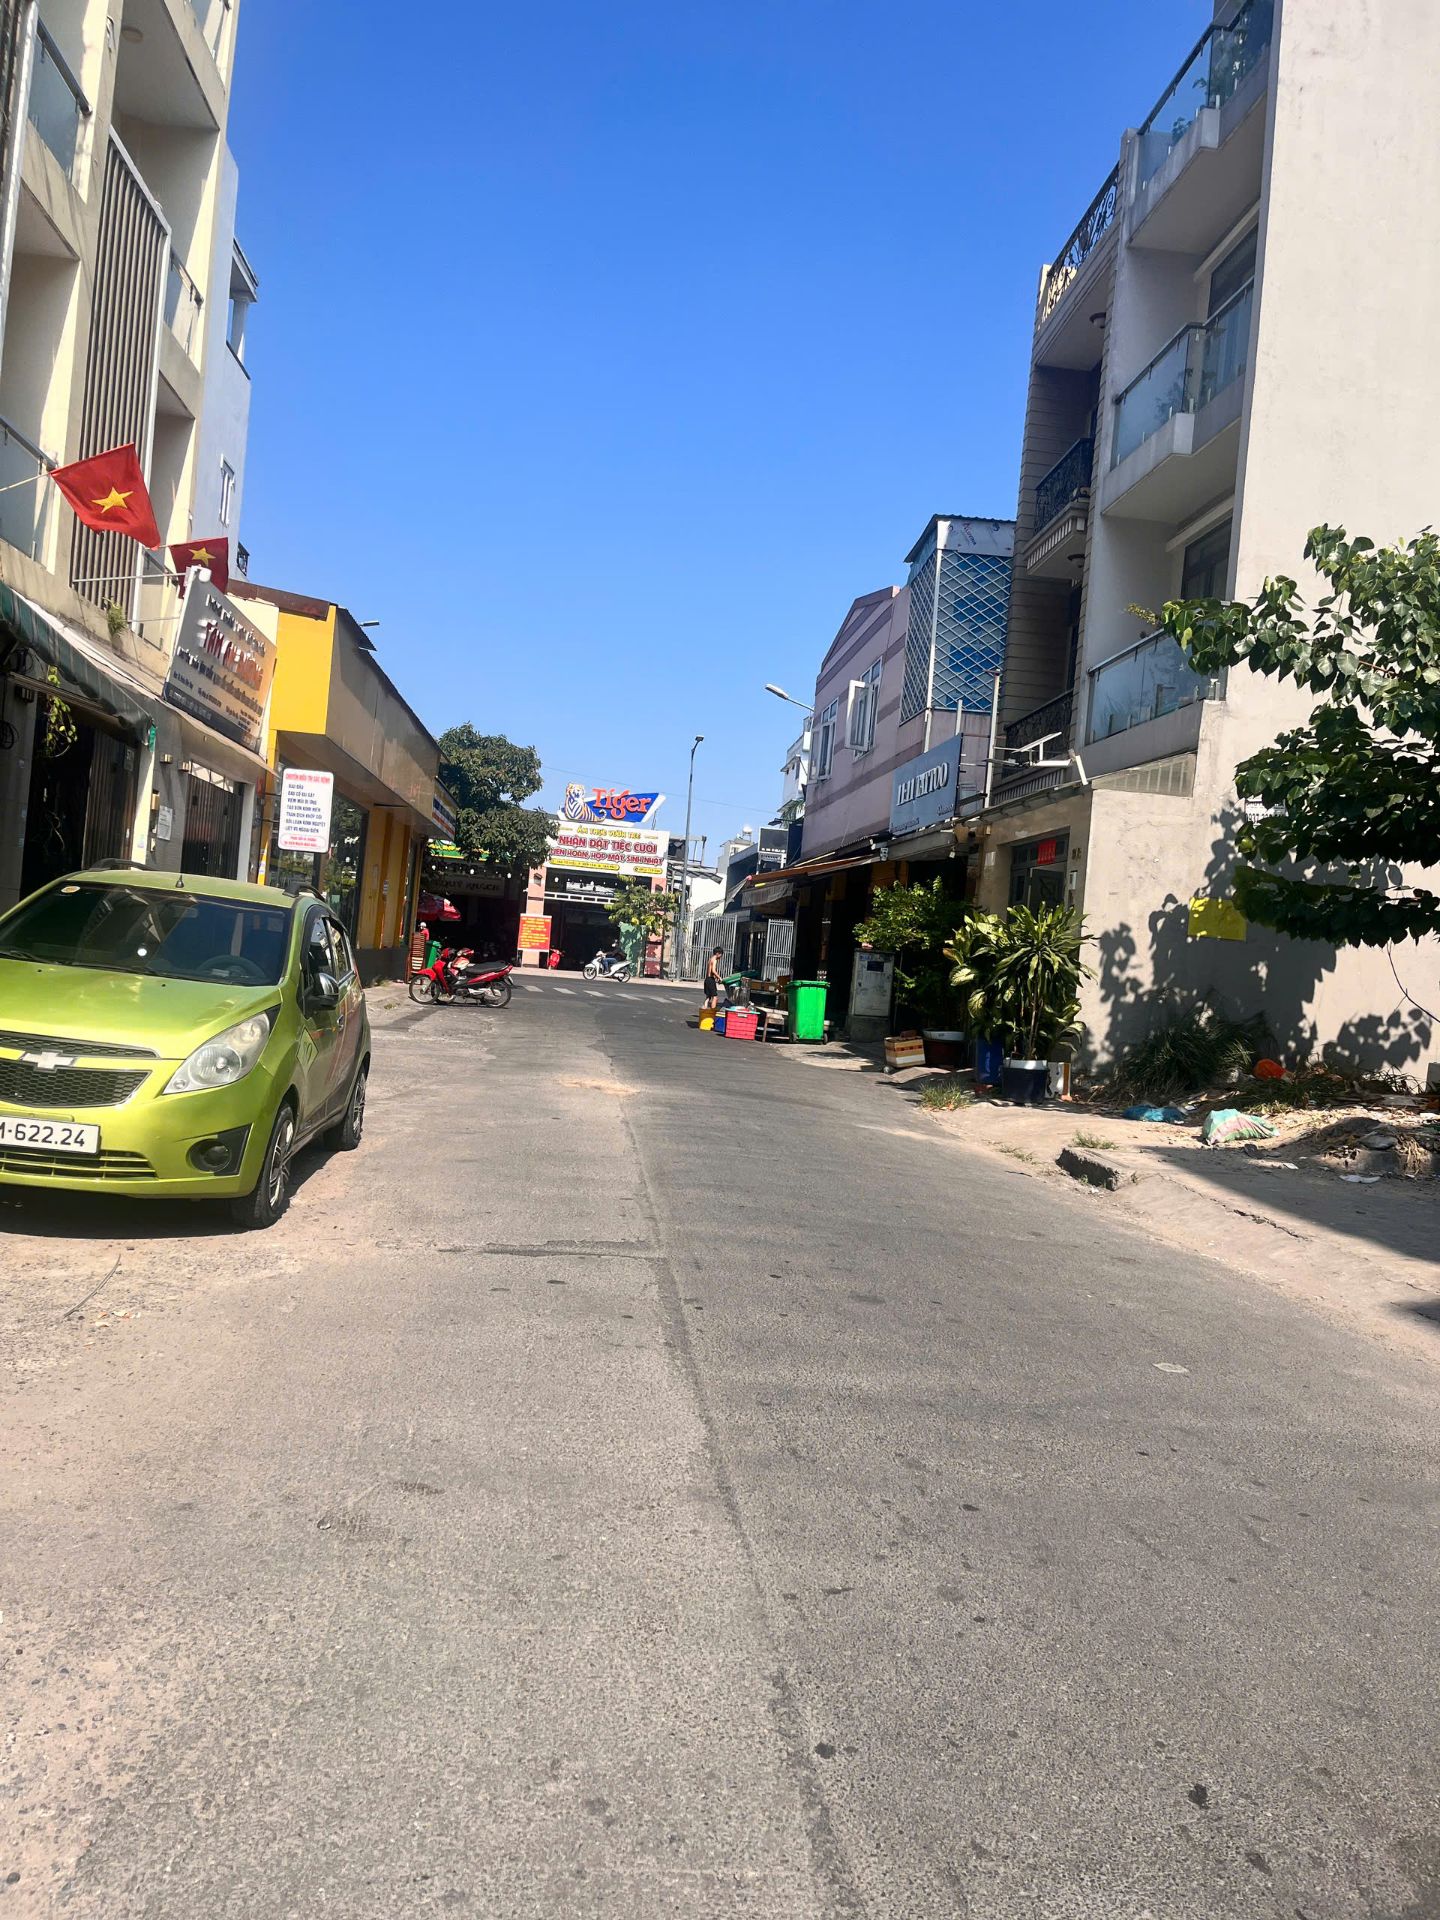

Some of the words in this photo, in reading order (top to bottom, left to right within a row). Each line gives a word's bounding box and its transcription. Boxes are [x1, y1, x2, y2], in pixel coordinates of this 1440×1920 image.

[592, 788, 651, 819] Tiger
[558, 836, 586, 849] NHẬN
[589, 838, 610, 852] ĐẶT
[611, 839, 631, 853] TIỆC
